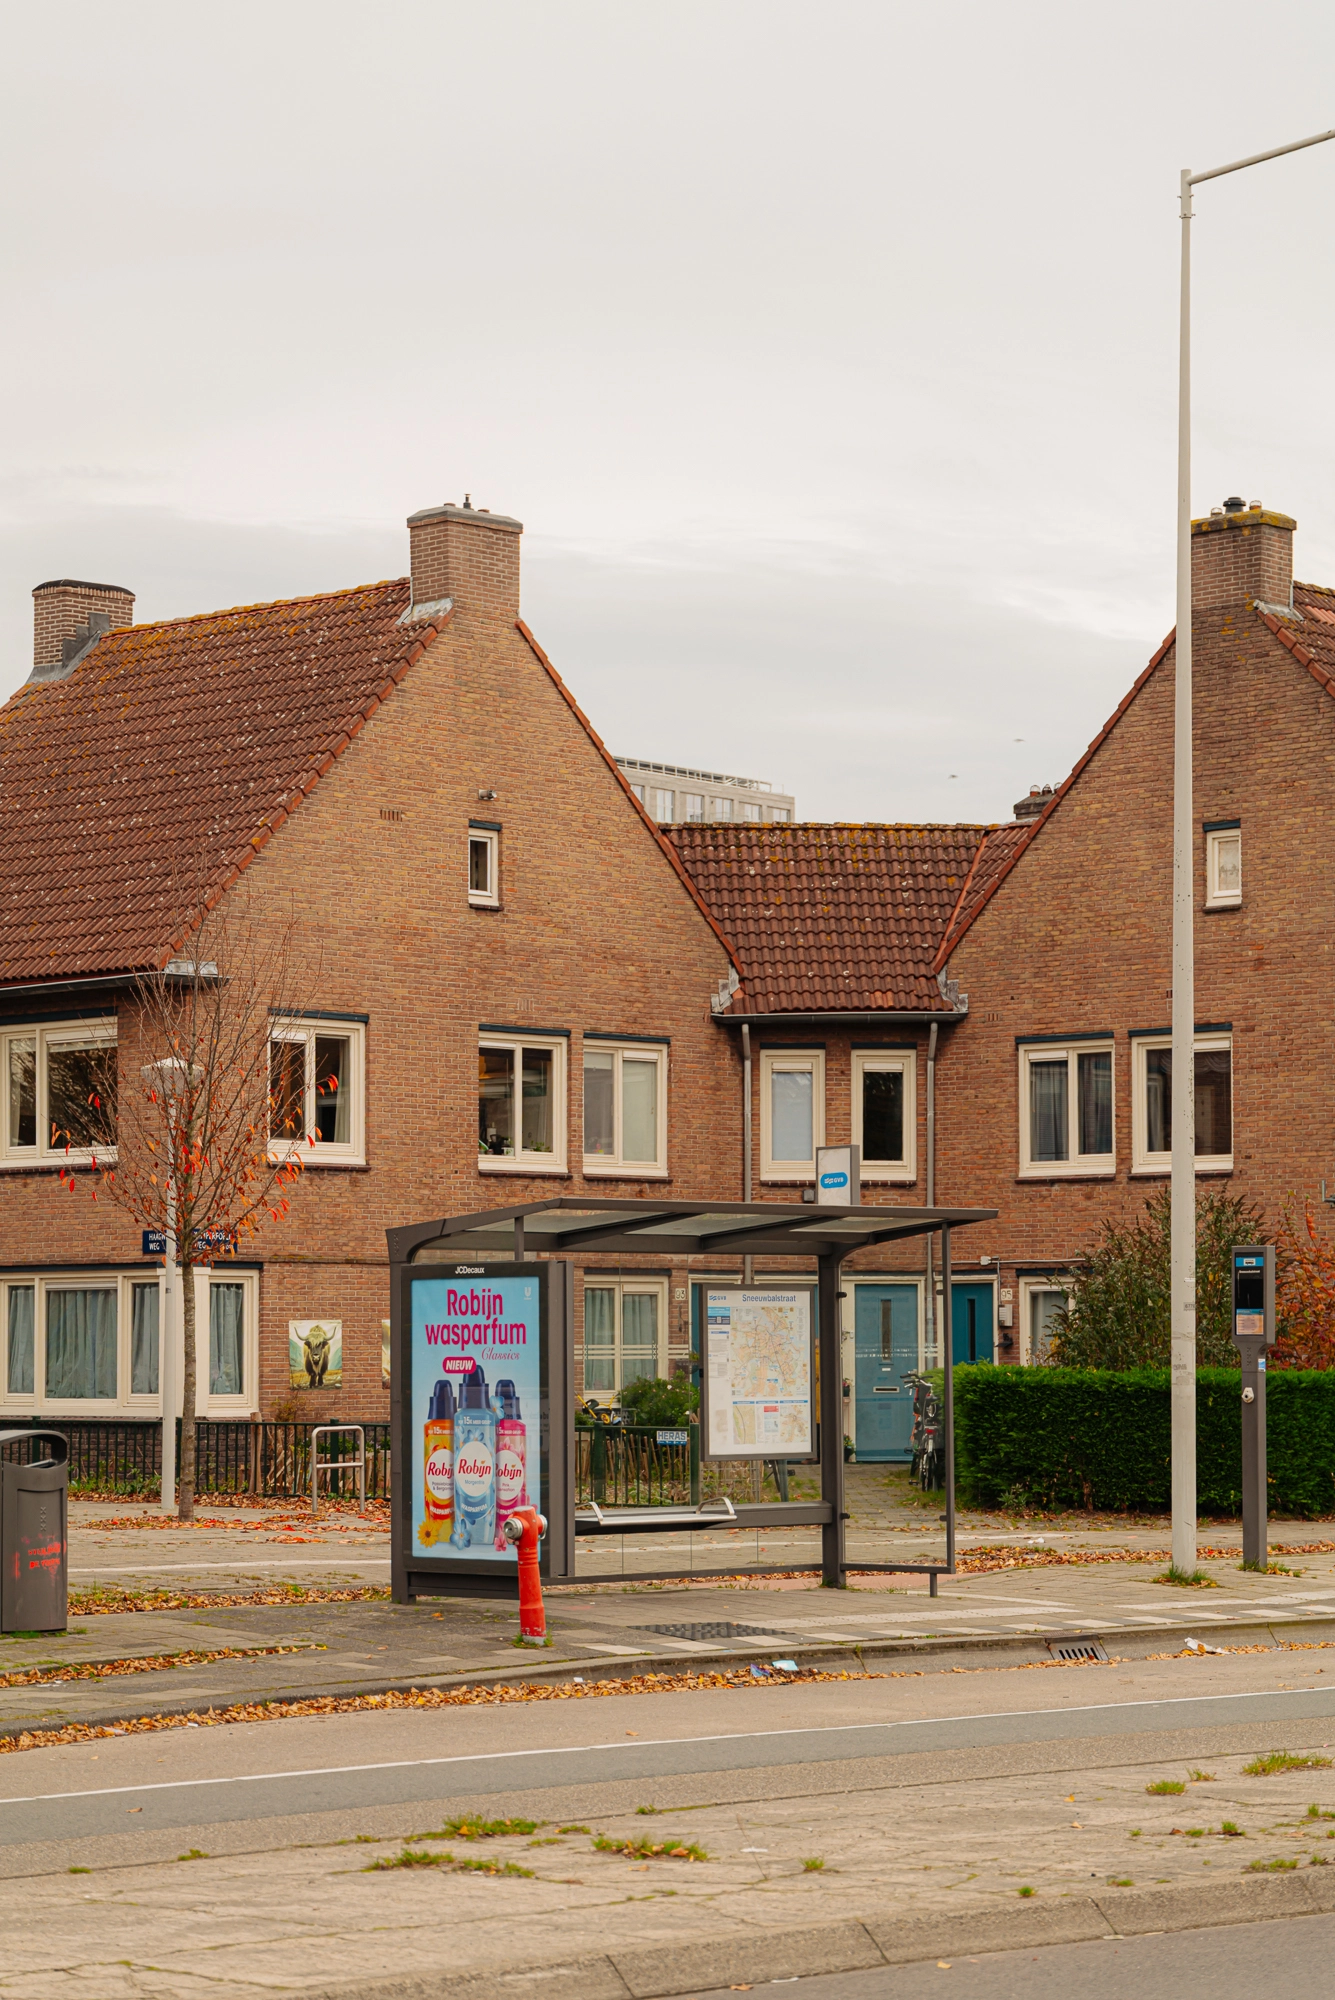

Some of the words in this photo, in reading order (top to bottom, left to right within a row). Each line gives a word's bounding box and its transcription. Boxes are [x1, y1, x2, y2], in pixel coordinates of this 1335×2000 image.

[149, 1242, 160, 1251] WEG
[455, 1266, 485, 1274] JCDecaux
[676, 1289, 685, 1299] 93
[742, 1293, 797, 1302] Sneeuwbalstraat
[1001, 1290, 1011, 1299] 95
[447, 1288, 503, 1321] Robijn
[425, 1317, 527, 1352] wasparfum
[481, 1347, 520, 1361] Classics
[445, 1359, 474, 1371] NIEUW
[658, 1431, 686, 1441] HERAS
[428, 1461, 454, 1479] Robij
[458, 1459, 492, 1478] Robijn
[461, 1502, 488, 1513] WASPARFUM
